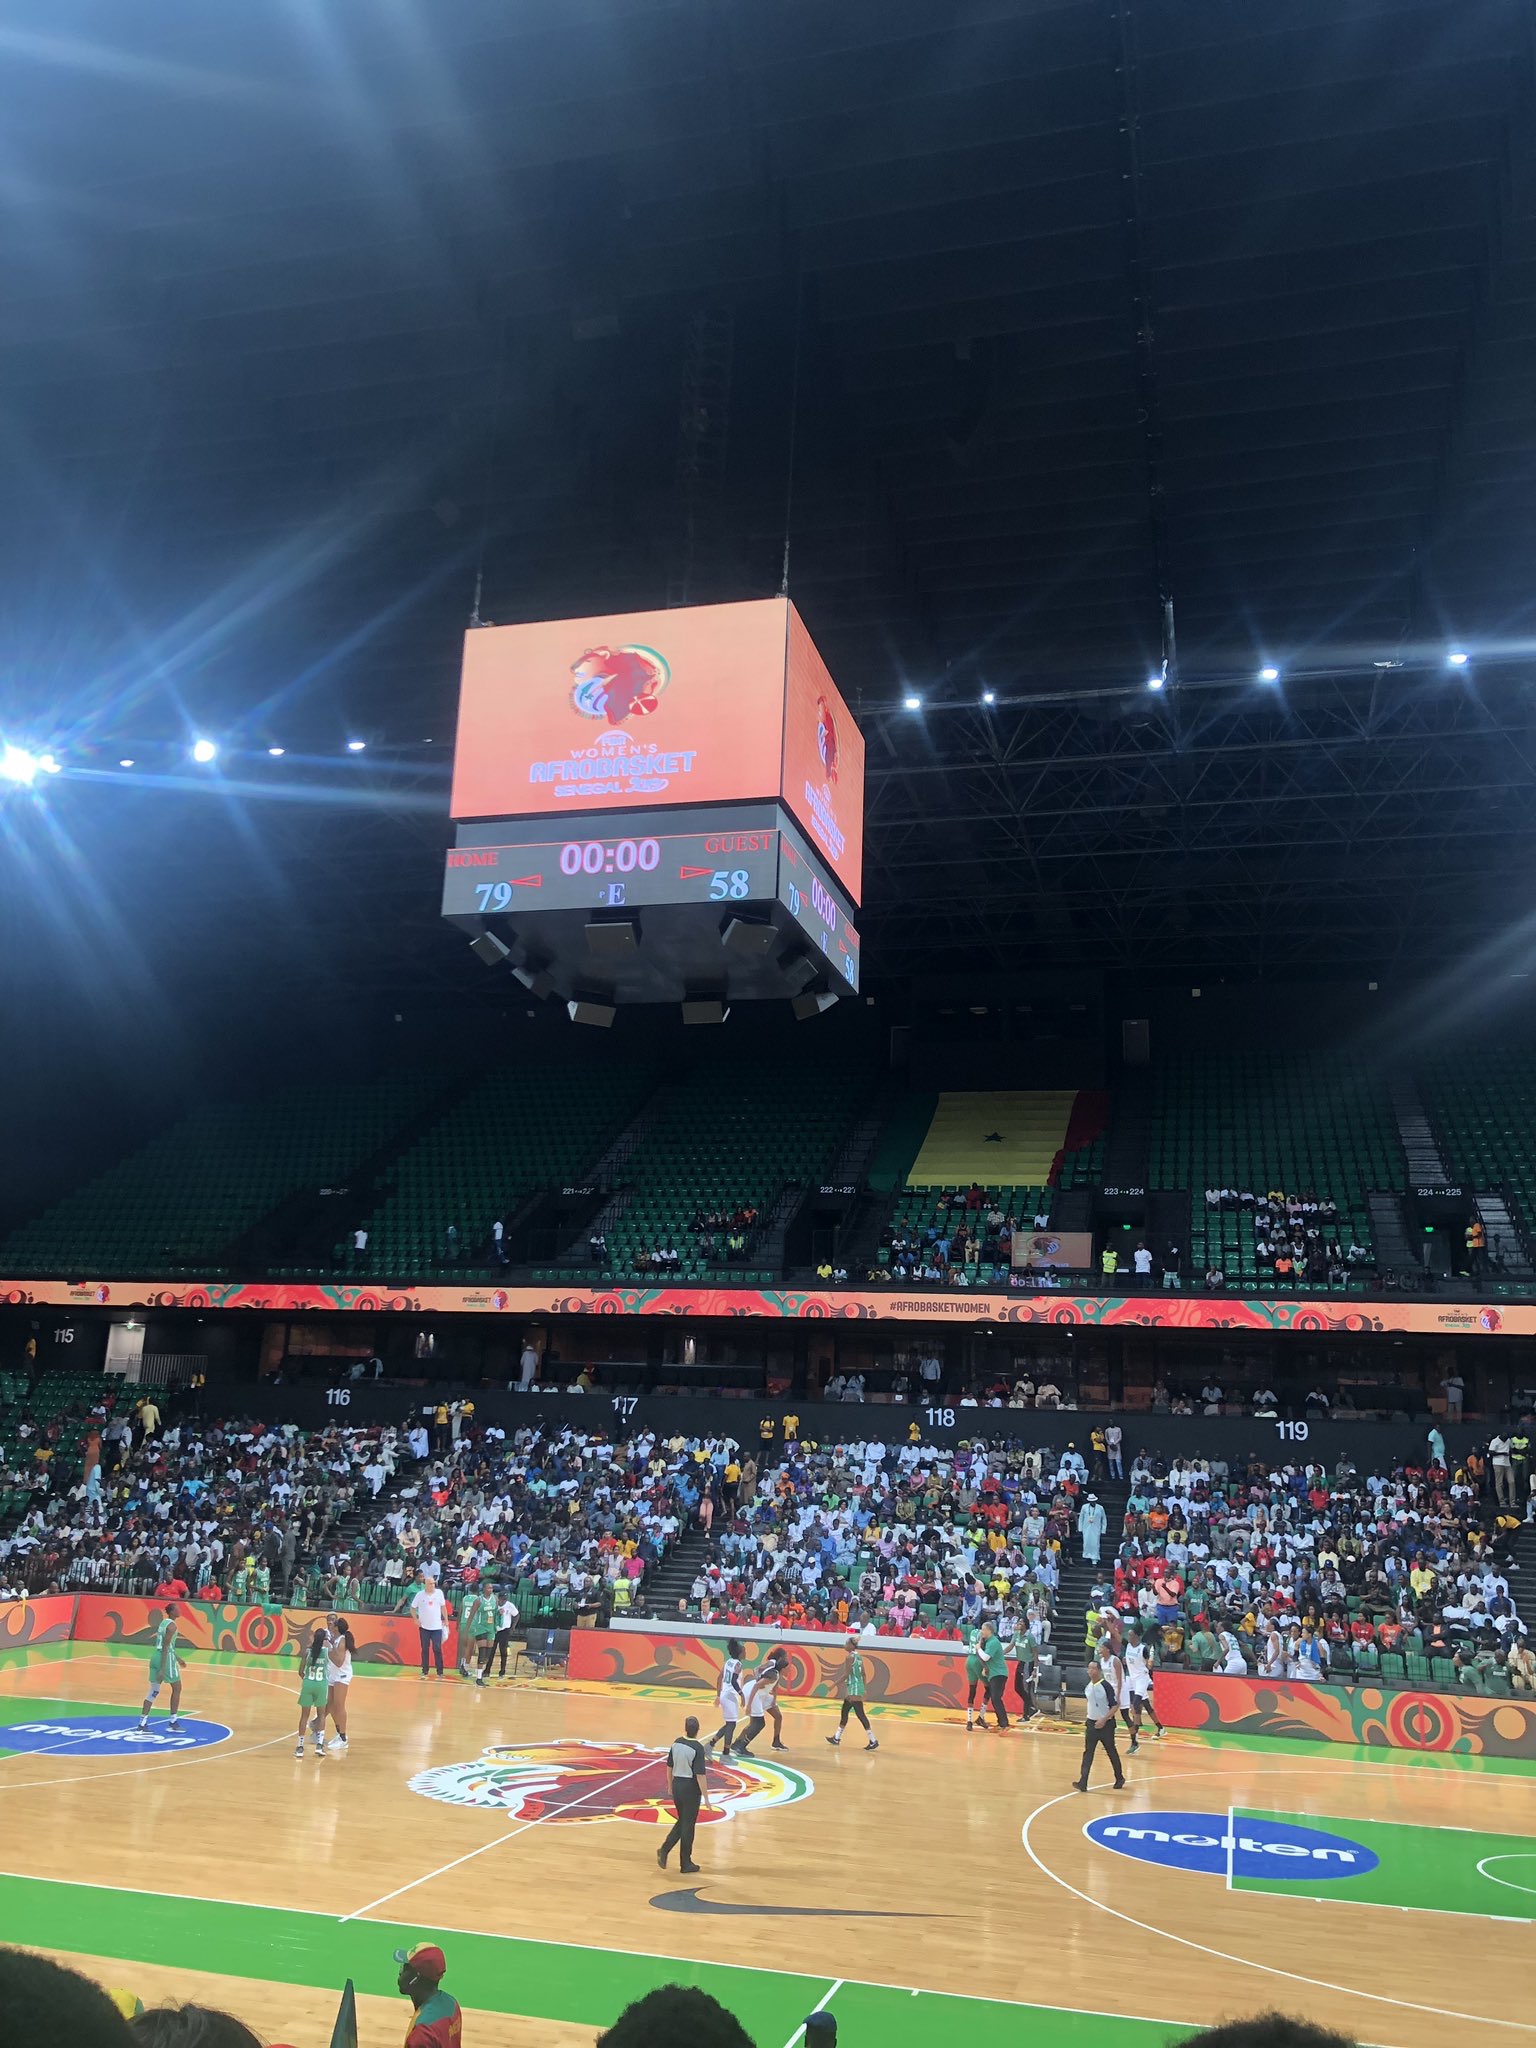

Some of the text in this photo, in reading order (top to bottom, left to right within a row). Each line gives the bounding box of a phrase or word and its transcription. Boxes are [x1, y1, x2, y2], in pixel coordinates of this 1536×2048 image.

[570, 743, 658, 760] WOMEN'S
[529, 751, 698, 783] AFROBASKET
[554, 781, 623, 797] SENEGAL
[704, 834, 774, 854] GUEST
[447, 852, 498, 868] HOME
[559, 838, 661, 875] 00:00
[606, 883, 626, 906] E
[708, 869, 750, 900] 58
[474, 881, 513, 912] 79
[788, 881, 800, 916] 79
[810, 876, 837, 932] 00:00
[845, 953, 855, 985] 58
[820, 1186, 834, 1194] 222
[1104, 1187, 1145, 1196] 223 224
[1417, 1188, 1462, 1196] 224 225
[889, 1301, 991, 1314] #AFROBASKETWOMEN
[54, 1328, 75, 1344] 115
[325, 1388, 351, 1406] 116
[611, 1396, 639, 1415] 117
[925, 1407, 956, 1427] 118
[1275, 1420, 1309, 1441] 119
[632, 1688, 921, 1718] DAR
[8, 1723, 197, 1747] molten
[1103, 1826, 1357, 1863] molten
